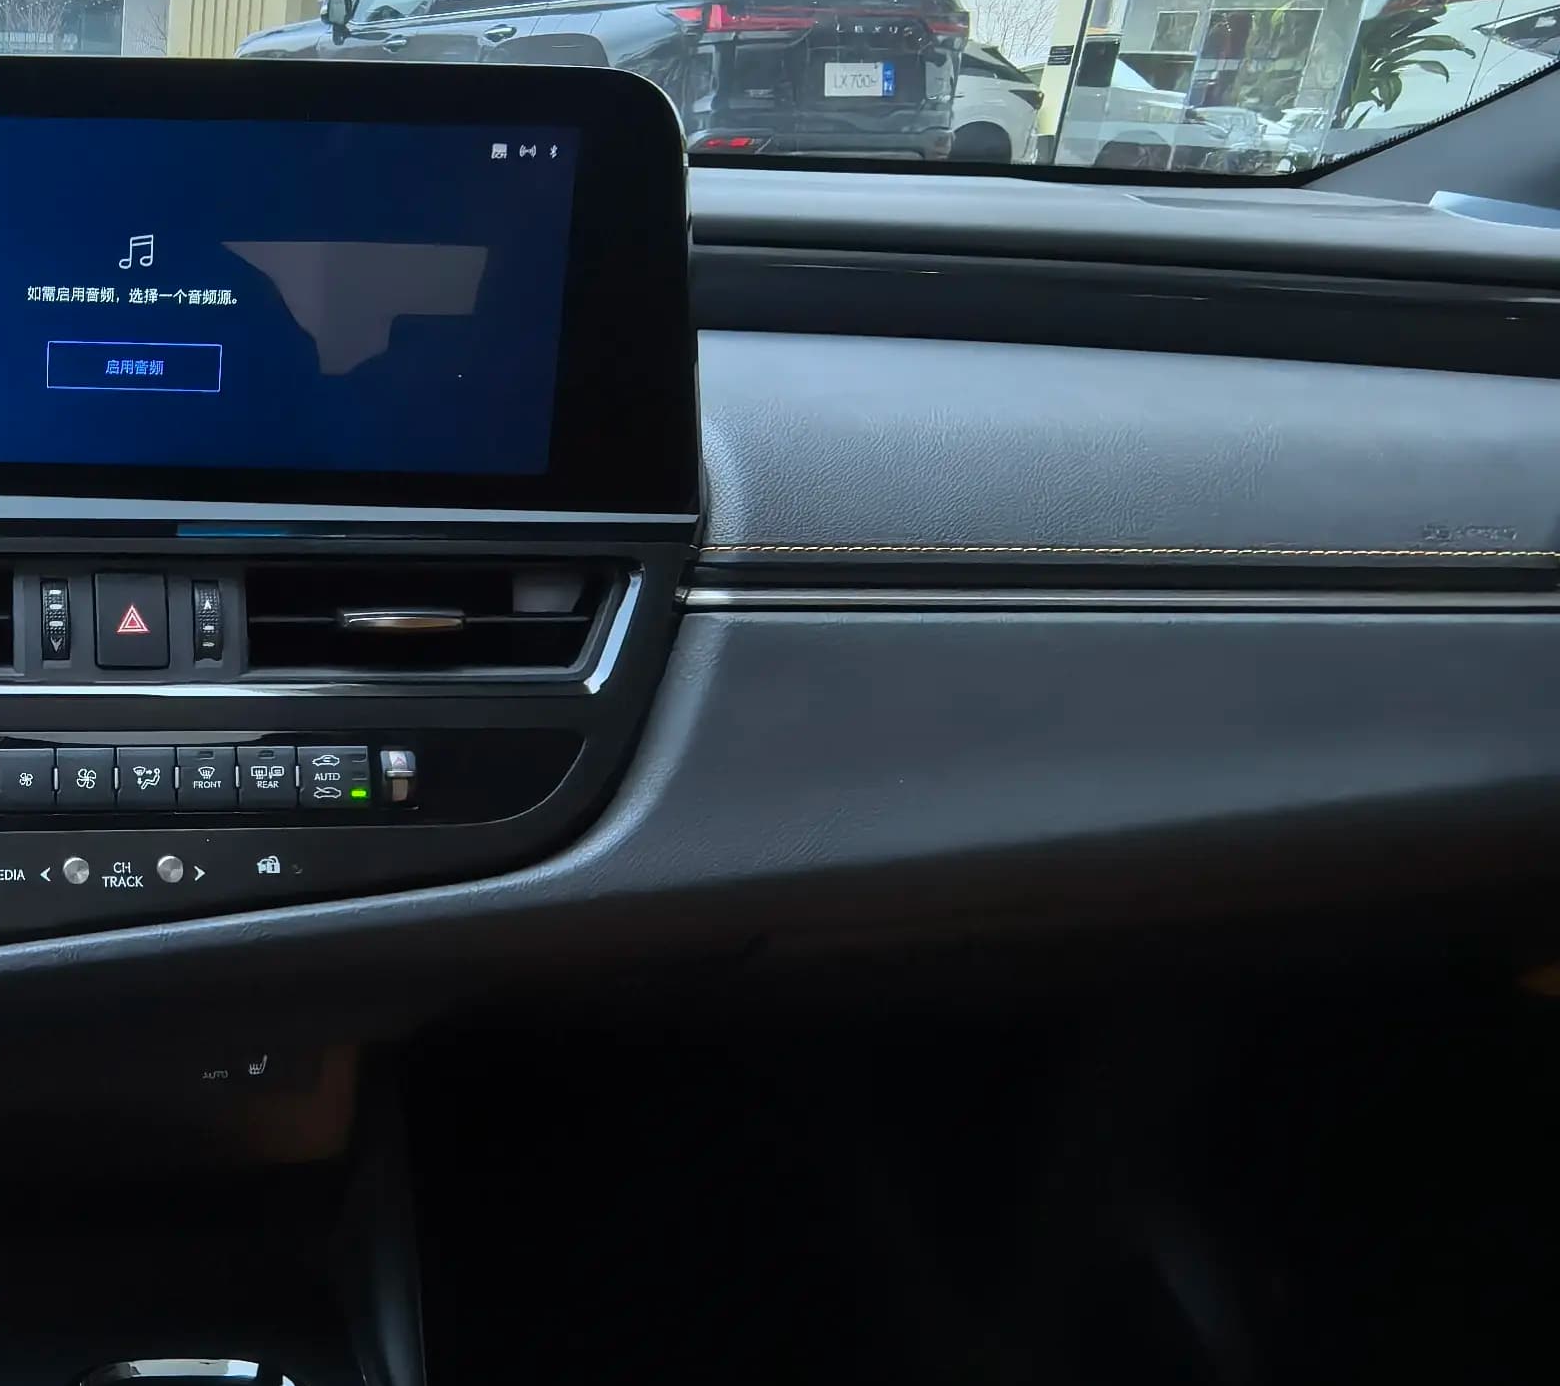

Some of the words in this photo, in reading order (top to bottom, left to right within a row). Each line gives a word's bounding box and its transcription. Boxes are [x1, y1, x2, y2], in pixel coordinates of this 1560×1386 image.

[26, 285, 238, 306] 如需启用音频，选择一个音频源。
[105, 359, 165, 376] 启用音频
[313, 772, 341, 782] AUTO
[193, 780, 222, 789] FRONT
[256, 780, 280, 789] REAR
[112, 861, 132, 874] CH
[101, 875, 144, 888] TRACK
